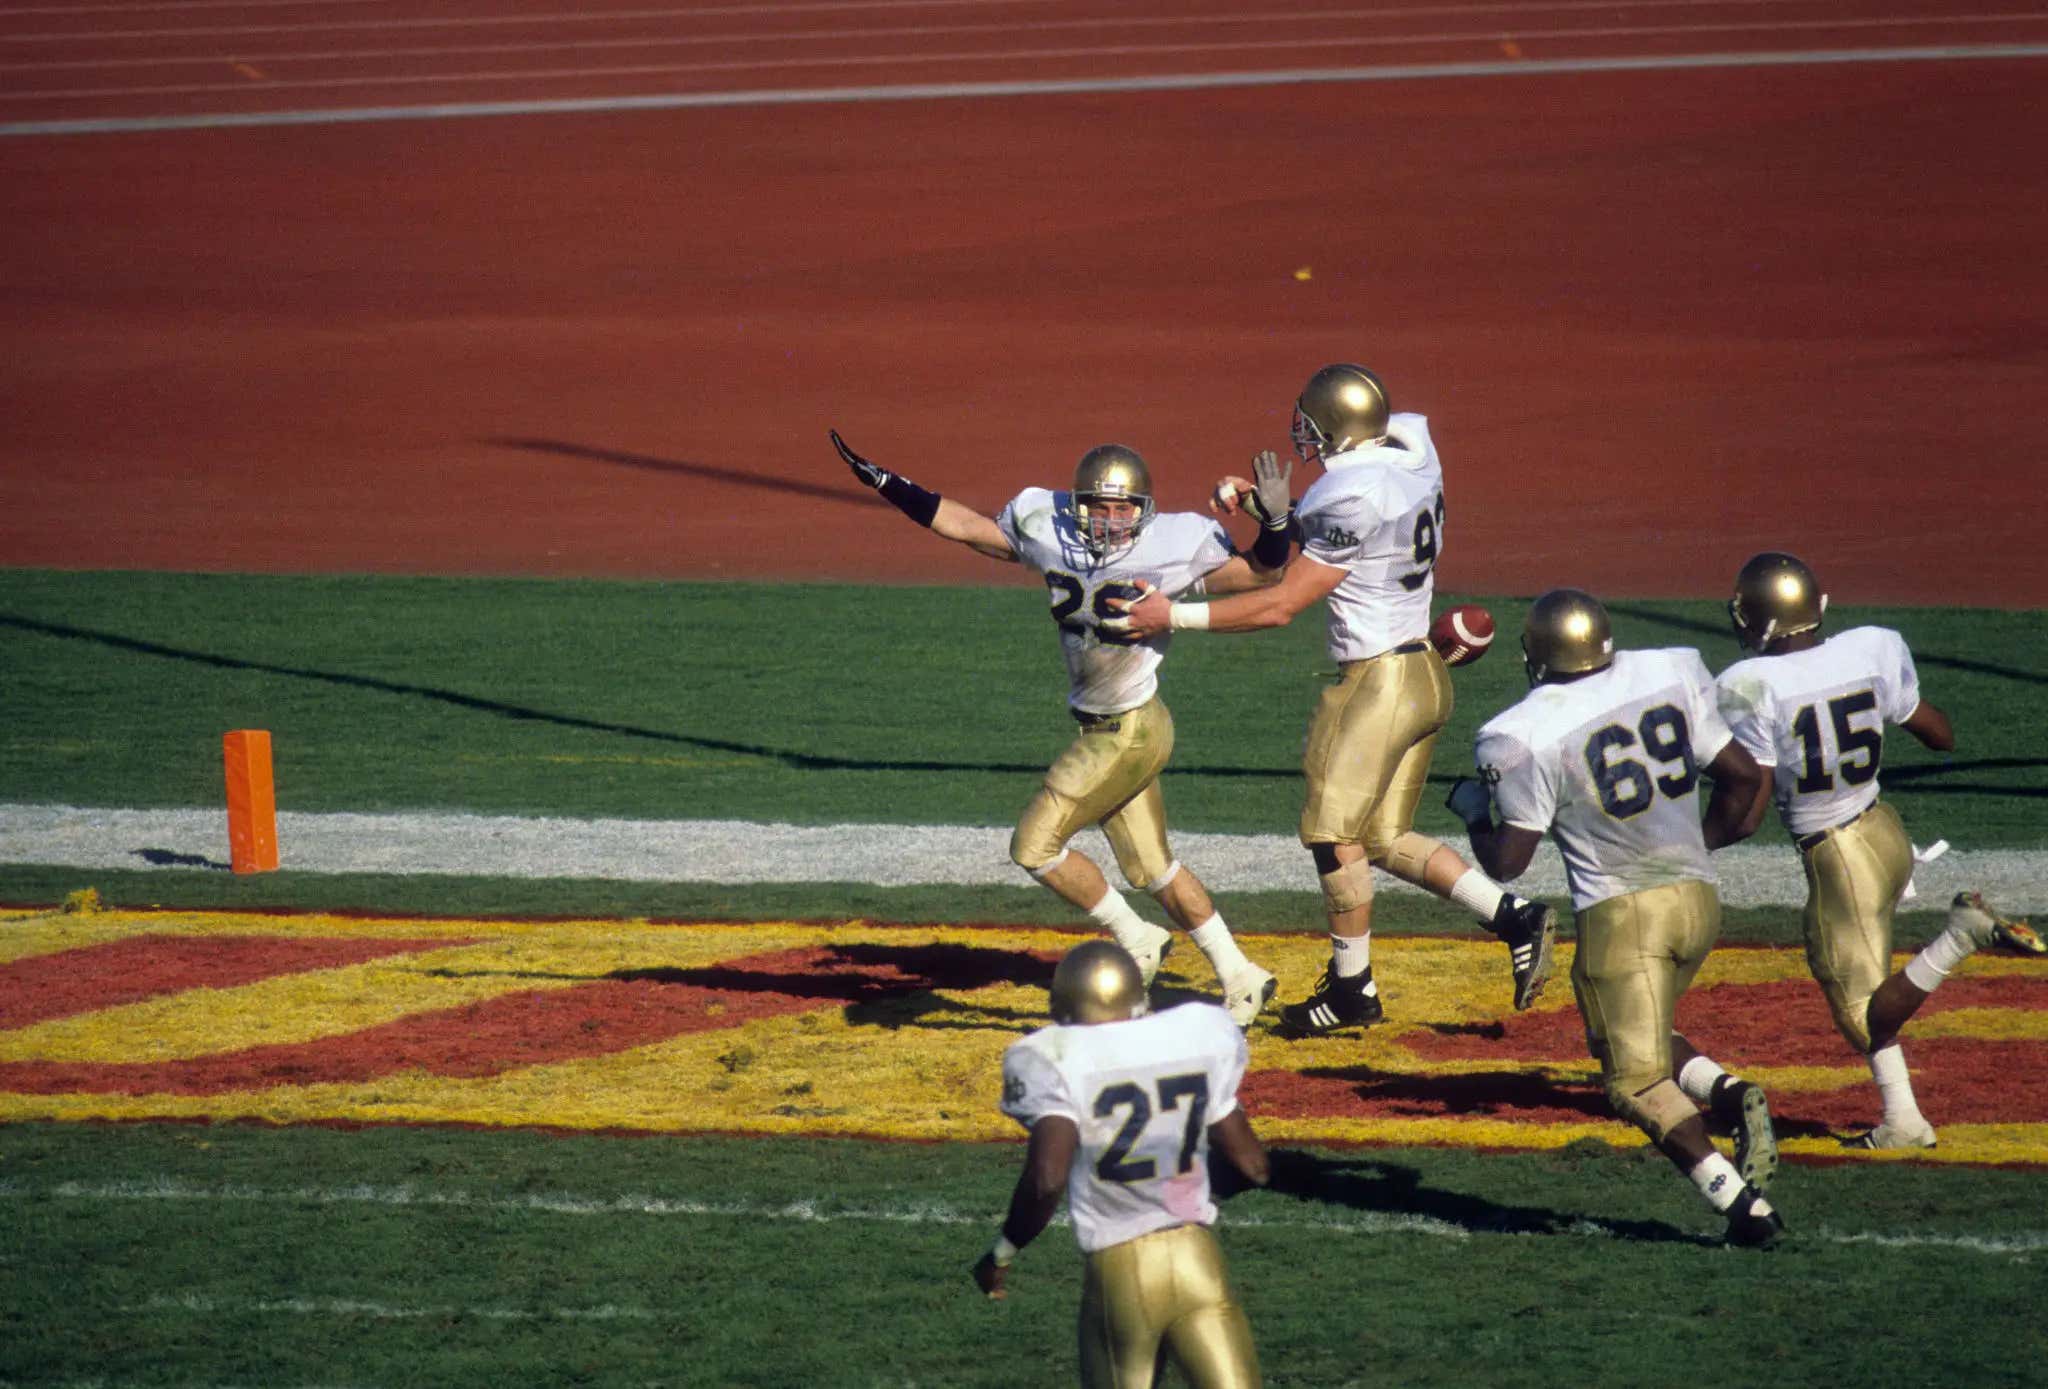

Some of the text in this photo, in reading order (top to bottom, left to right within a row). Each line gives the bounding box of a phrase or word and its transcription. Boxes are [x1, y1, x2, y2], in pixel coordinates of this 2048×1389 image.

[1585, 703, 1697, 822] 69
[1791, 688, 1883, 794] 15
[1092, 1072, 1210, 1183] 27
